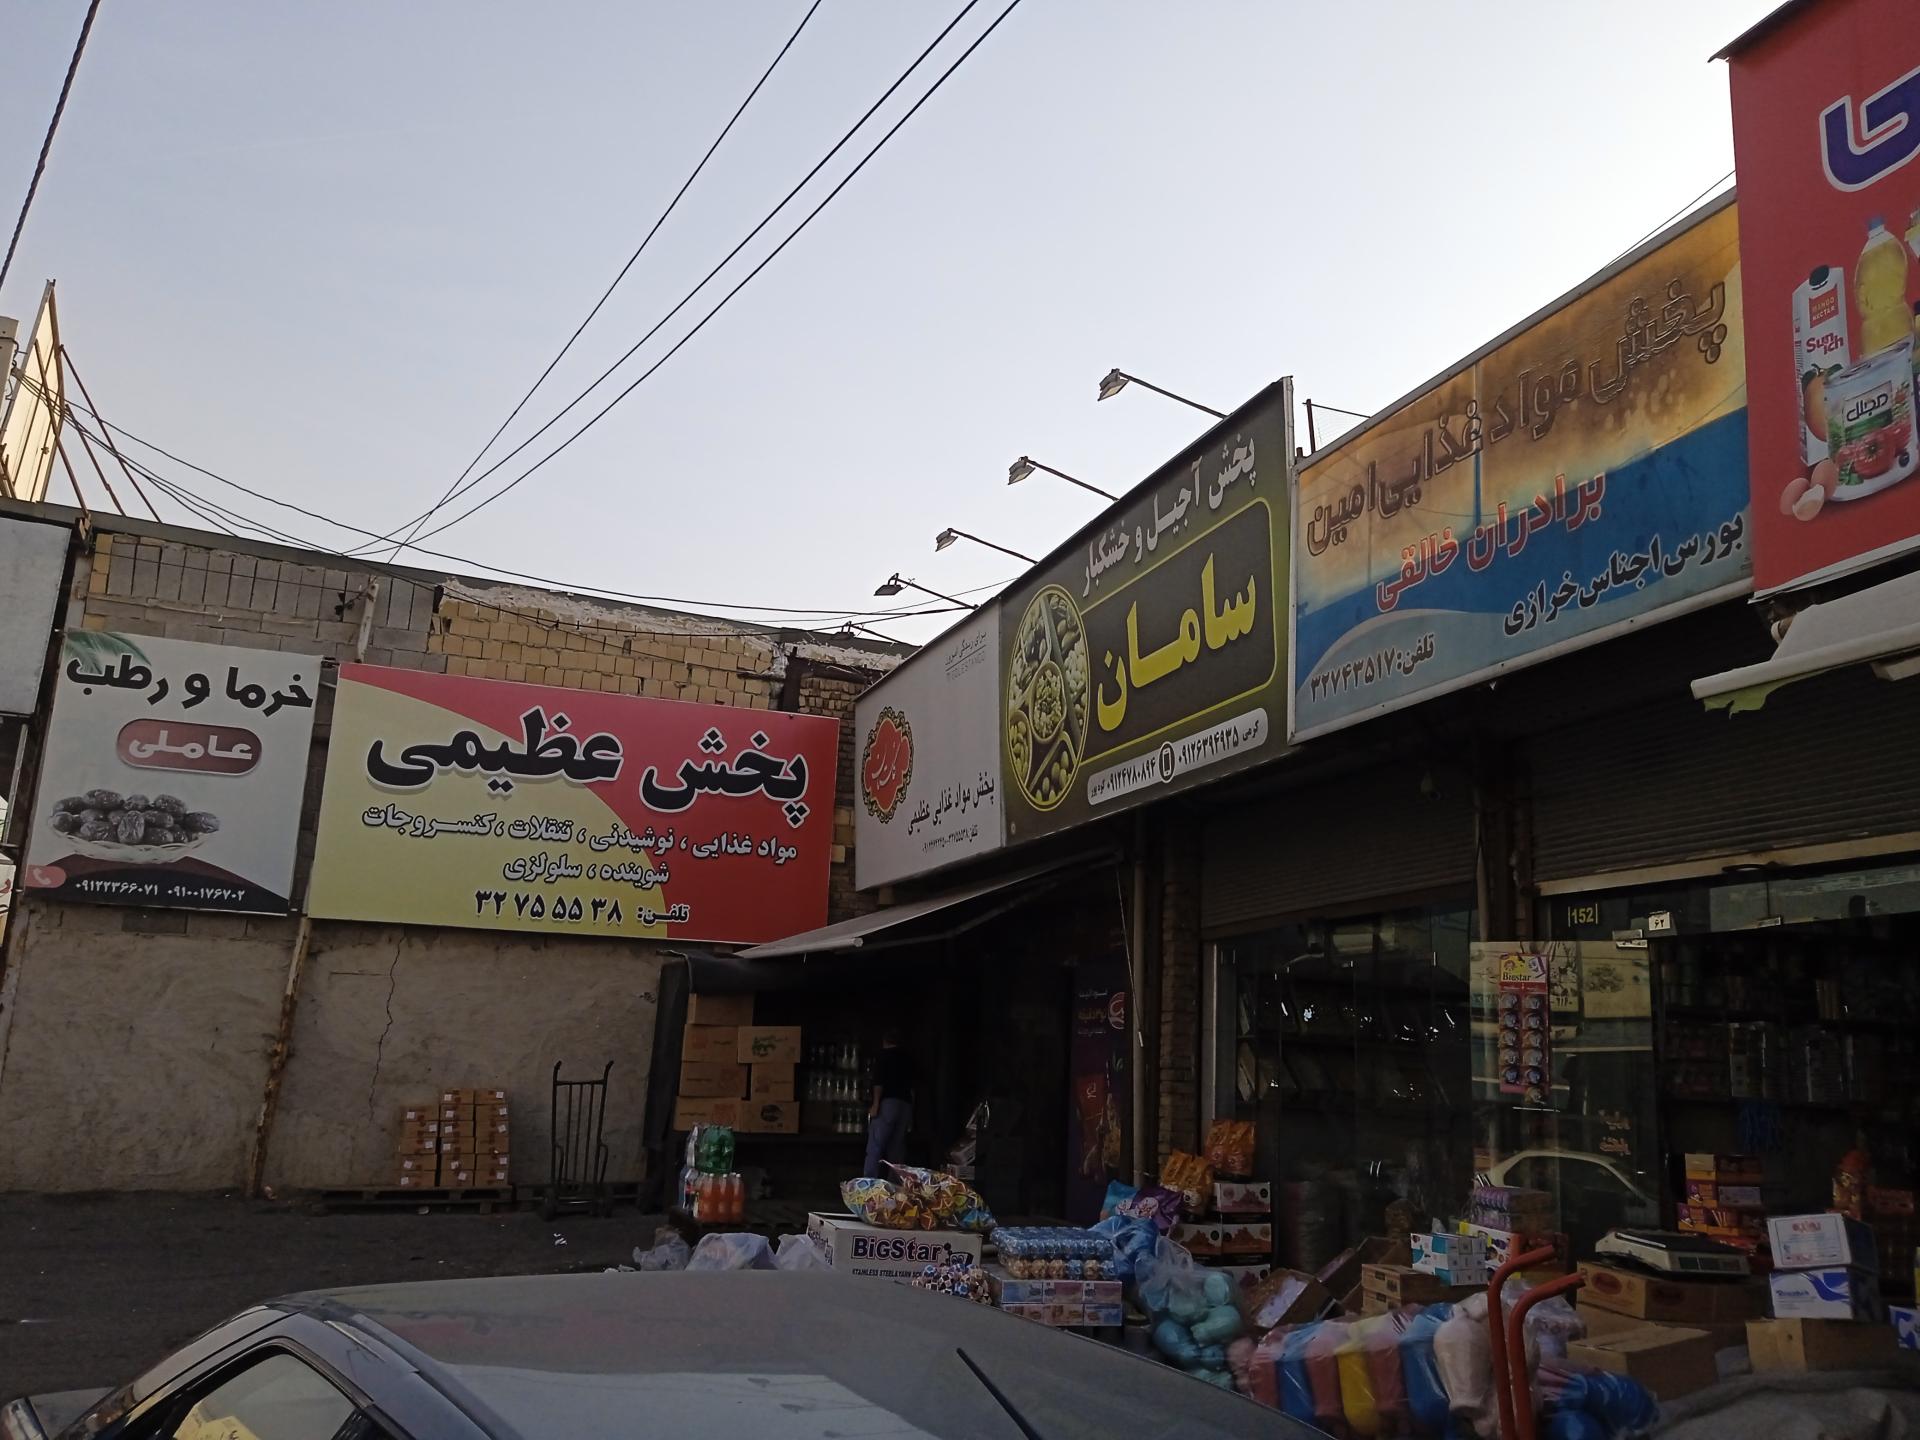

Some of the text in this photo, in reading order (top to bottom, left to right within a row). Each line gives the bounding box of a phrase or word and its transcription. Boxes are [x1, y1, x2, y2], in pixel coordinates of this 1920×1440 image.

[1307, 278, 1727, 557] پخش مواد غذایی امین
[1082, 433, 1257, 599] پخش آجیل و خشکبار
[1375, 471, 1606, 613] برادران خالقی
[1503, 512, 1745, 637] بورس اجناس خرازی
[1096, 552, 1257, 732] سامان
[66, 654, 315, 717] خرما و رطب
[1310, 646, 1397, 704] ۳۲۷۴۳۵۱۷
[128, 730, 253, 761] عاملی
[367, 704, 809, 828] پخش عظیمی
[508, 815, 573, 842] تنقلات
[907, 771, 996, 836] پخش مواد غذایی عظیمی
[503, 852, 583, 883] سلولزی
[589, 823, 674, 855] نوشیدنی
[692, 832, 753, 859] غذایی
[757, 834, 798, 864] مواد
[600, 861, 671, 890] شوینده
[1571, 906, 1595, 925] 152
